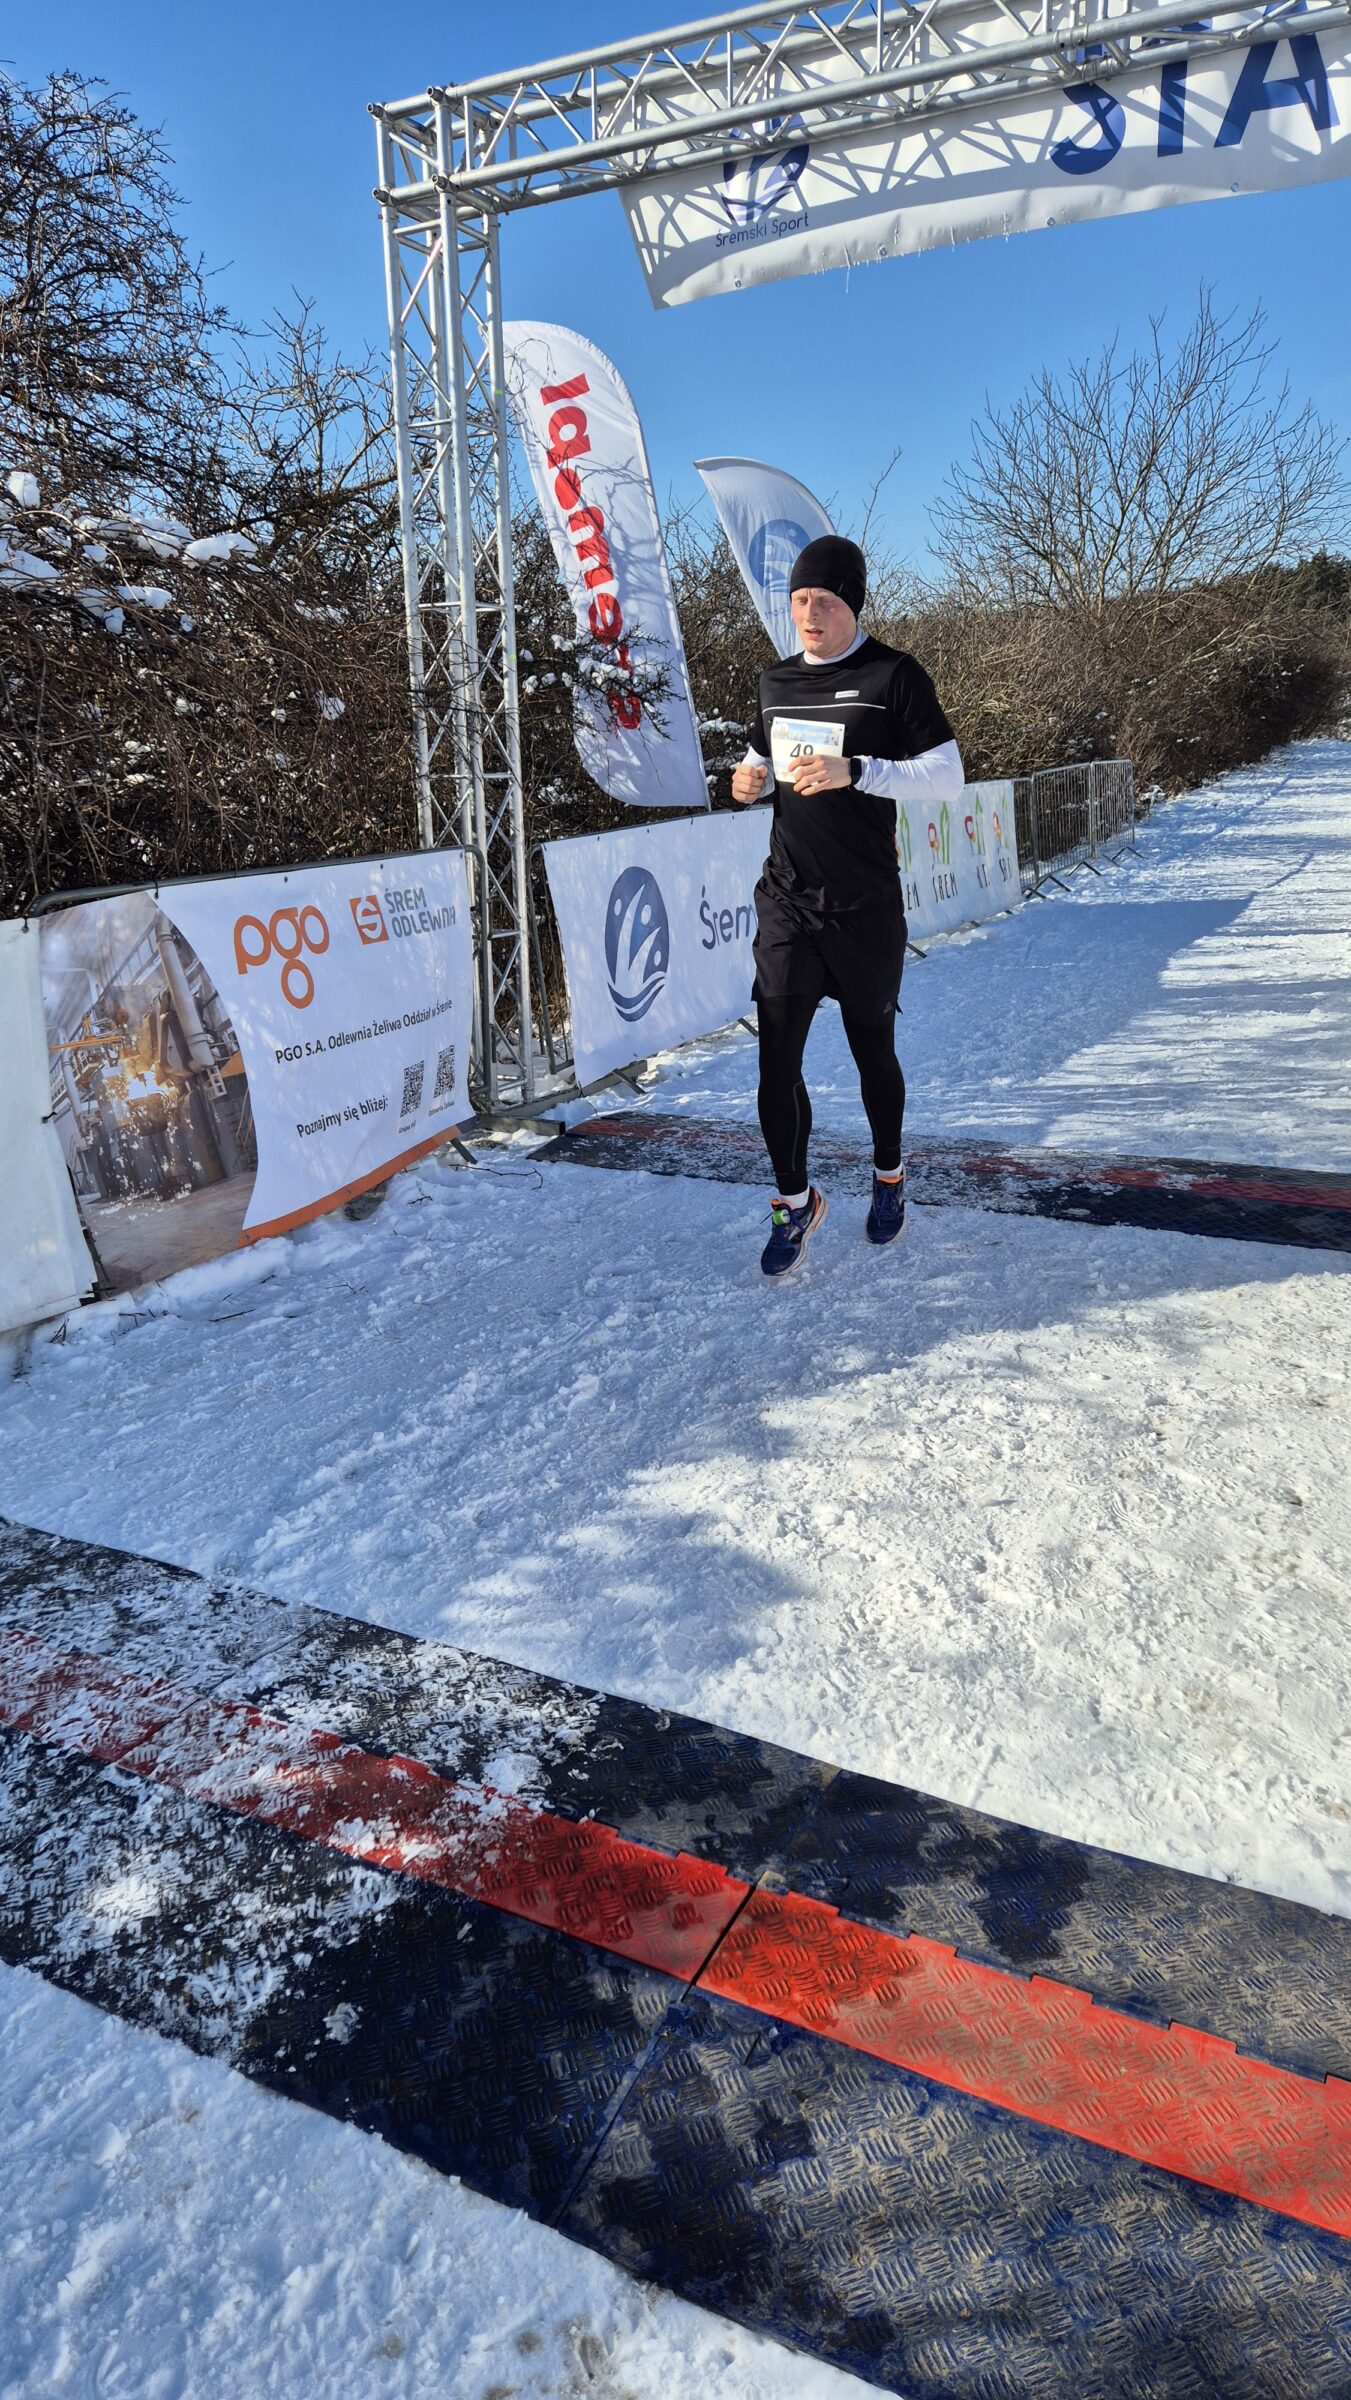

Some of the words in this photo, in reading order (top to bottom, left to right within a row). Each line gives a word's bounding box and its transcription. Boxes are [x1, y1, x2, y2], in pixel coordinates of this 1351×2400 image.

[715, 224, 767, 247] Śremski
[771, 212, 809, 237] Sport
[384, 888, 427, 914] ŚREM
[275, 1044, 303, 1064] PGO
[305, 1039, 326, 1056] S.A.
[328, 1026, 372, 1049] Odlewnia
[373, 1018, 402, 1036] Żeliwa
[403, 1007, 431, 1027] Oddział
[296, 1111, 342, 1138] Poznajmy
[343, 1105, 360, 1122] się
[359, 1095, 389, 1116] bliżej:
